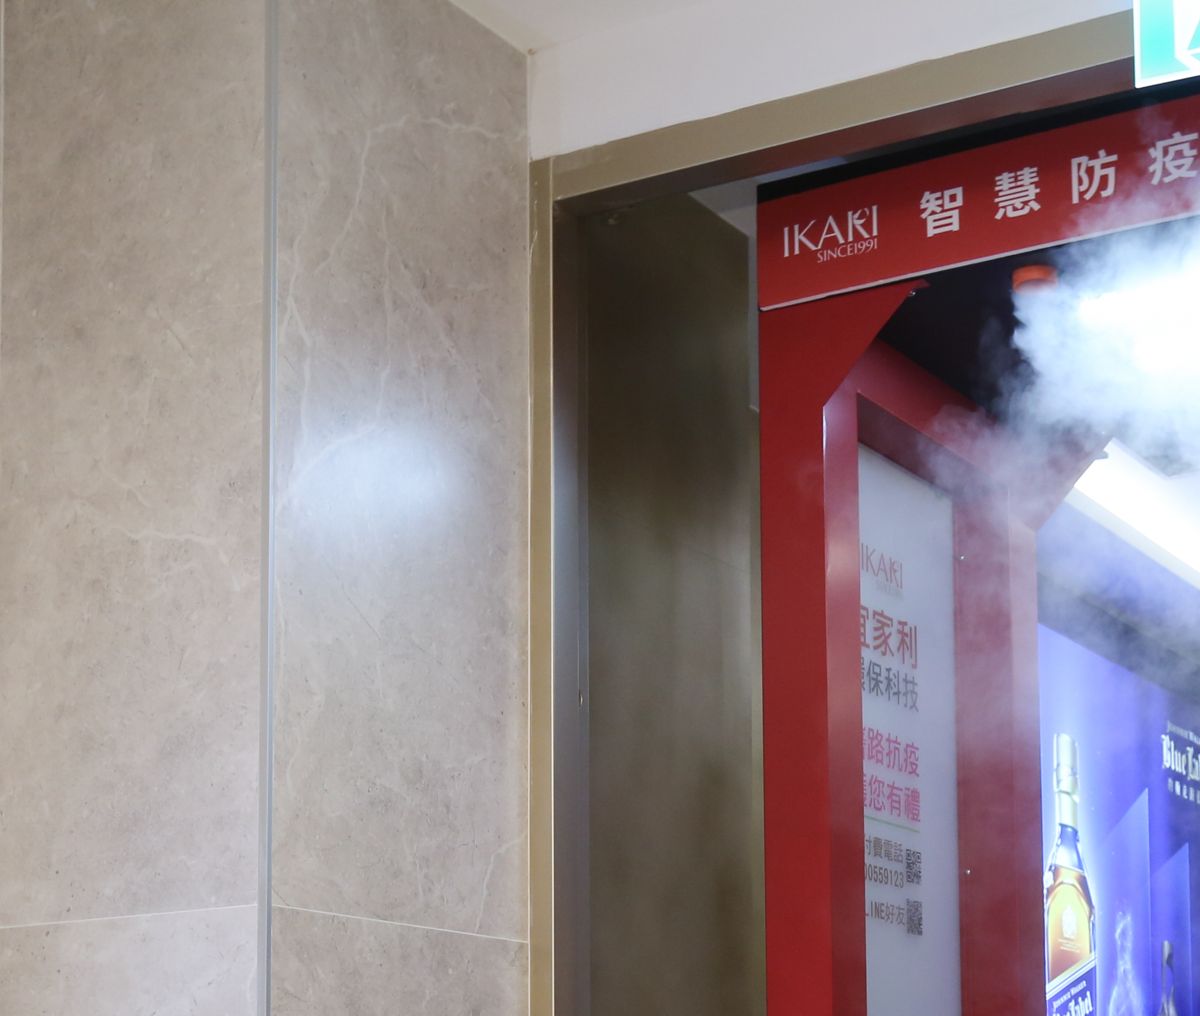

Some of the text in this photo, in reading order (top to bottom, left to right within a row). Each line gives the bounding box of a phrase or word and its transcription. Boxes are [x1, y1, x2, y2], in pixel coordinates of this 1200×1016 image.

[783, 205, 878, 258] IKAKI
[860, 656, 919, 712] 保科技
[862, 727, 920, 777] 路抗疫
[864, 773, 921, 823] 您有禮
[864, 900, 905, 927] INE好友
